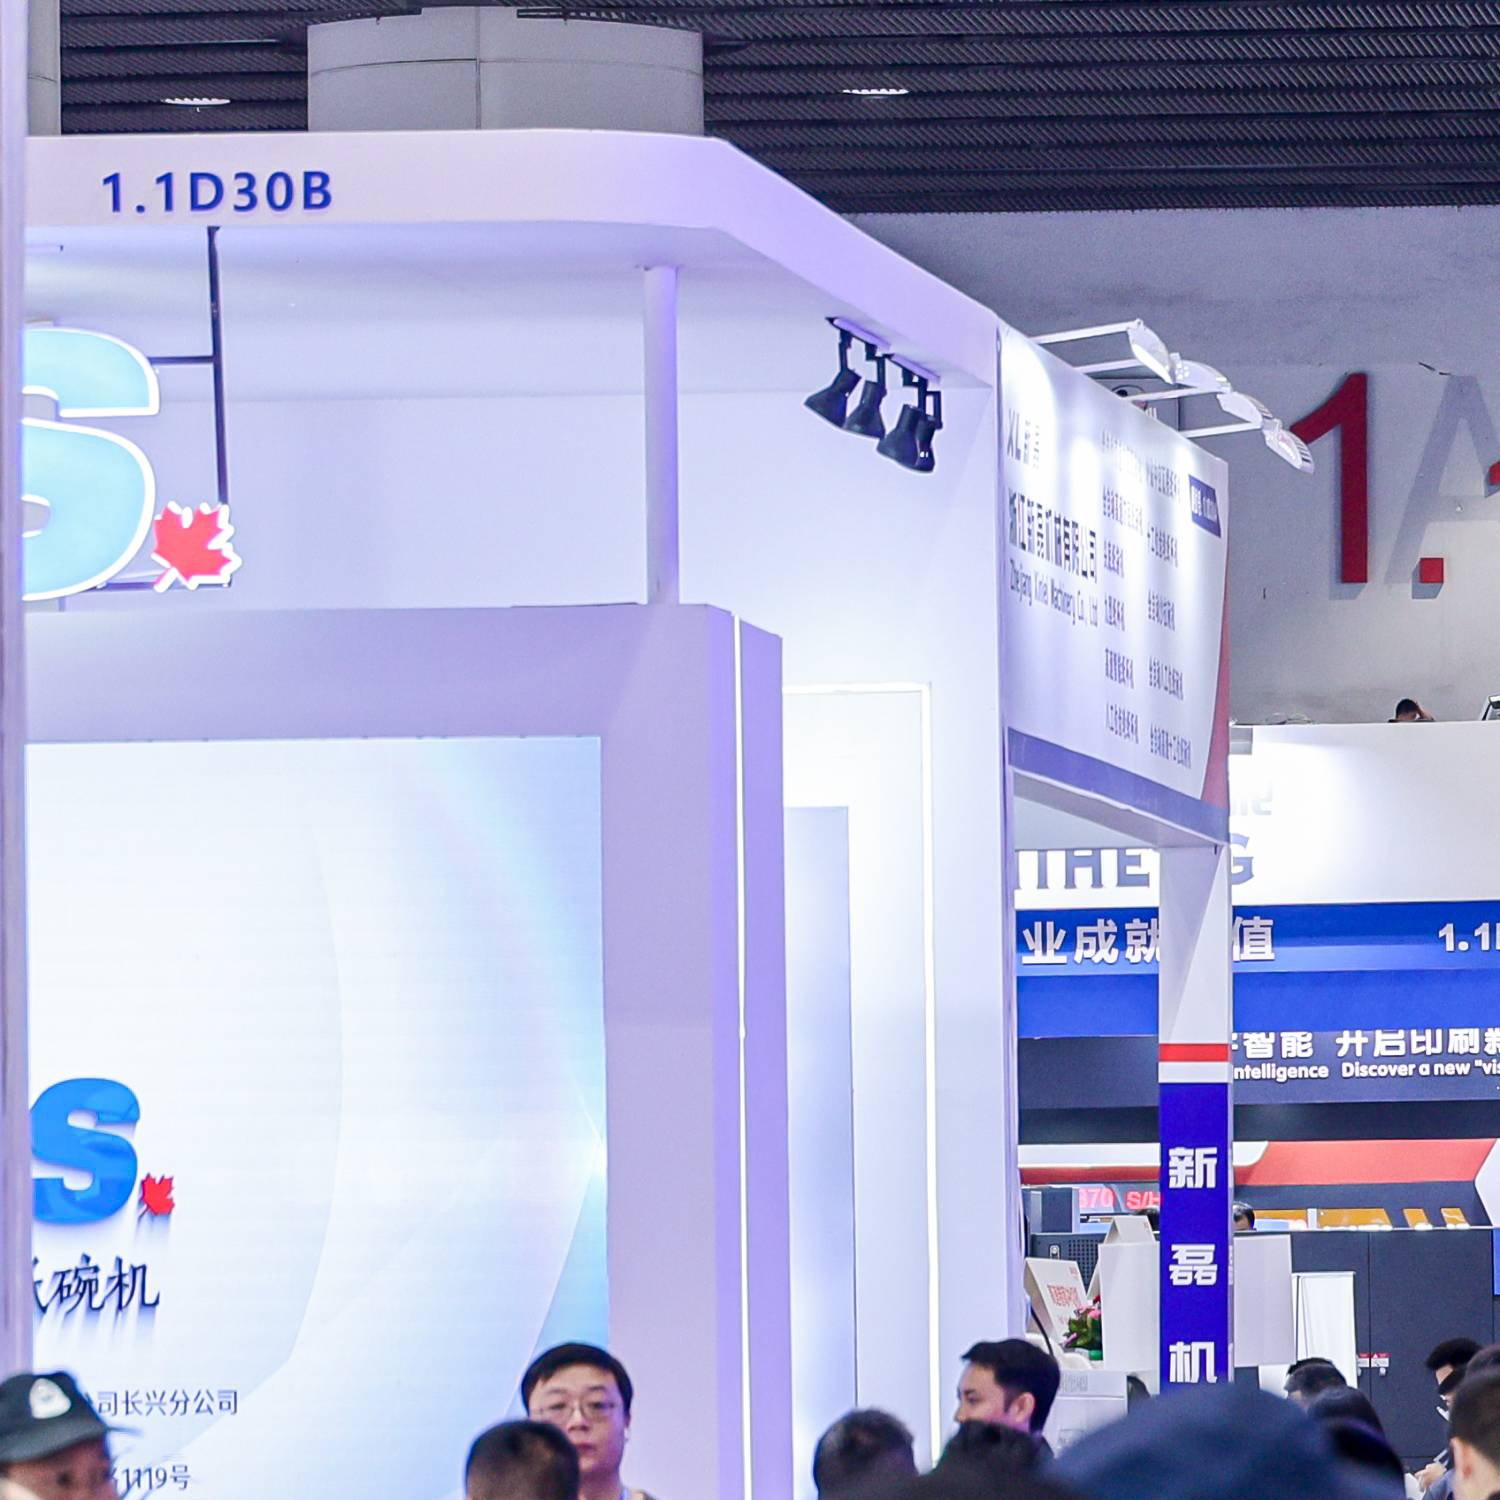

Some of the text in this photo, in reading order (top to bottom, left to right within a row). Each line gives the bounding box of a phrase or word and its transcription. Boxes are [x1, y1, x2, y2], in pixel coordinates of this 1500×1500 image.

[102, 171, 333, 214] 1.1D30B
[1021, 914, 1276, 966] 业成就值
[1233, 1062, 1329, 1083] ntelligence
[1341, 1060, 1417, 1079] Discover
[1419, 1063, 1430, 1077] a
[1433, 1062, 1471, 1077] new
[91, 1389, 238, 1416] 司长兴分公司
[112, 1464, 191, 1491] 1119号
